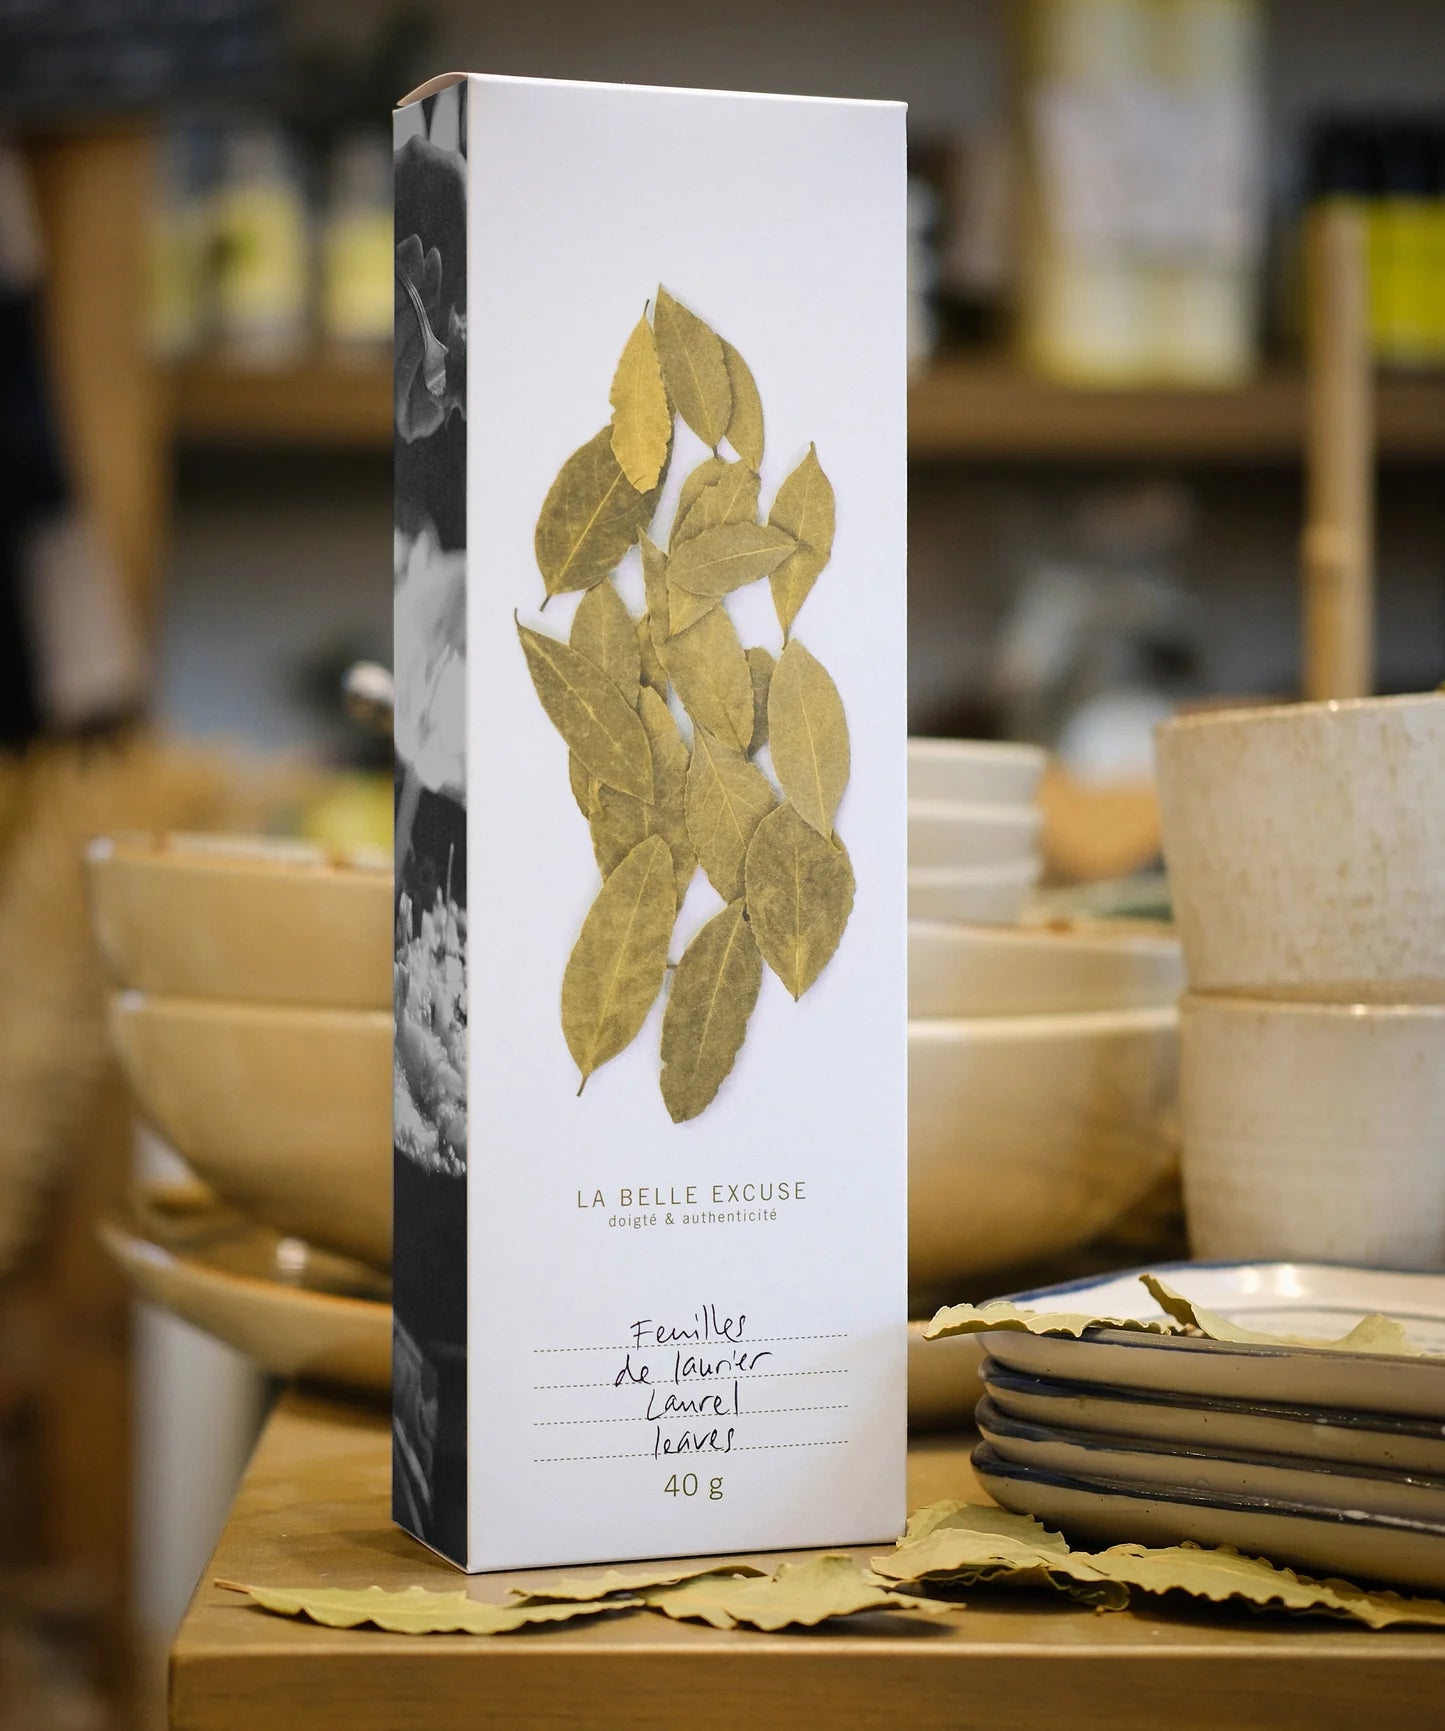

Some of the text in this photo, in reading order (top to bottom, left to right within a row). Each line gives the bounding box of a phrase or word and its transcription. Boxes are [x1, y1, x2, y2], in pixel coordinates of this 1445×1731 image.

[577, 1181, 807, 1208] LA BELLE EXCUSE
[608, 1208, 777, 1229] doigté & authenticité
[630, 1304, 746, 1350] Feuilles
[614, 1350, 772, 1388] de laurier
[646, 1380, 739, 1421] Laurel
[654, 1425, 735, 1460] leaves
[664, 1472, 724, 1500] 40 g
